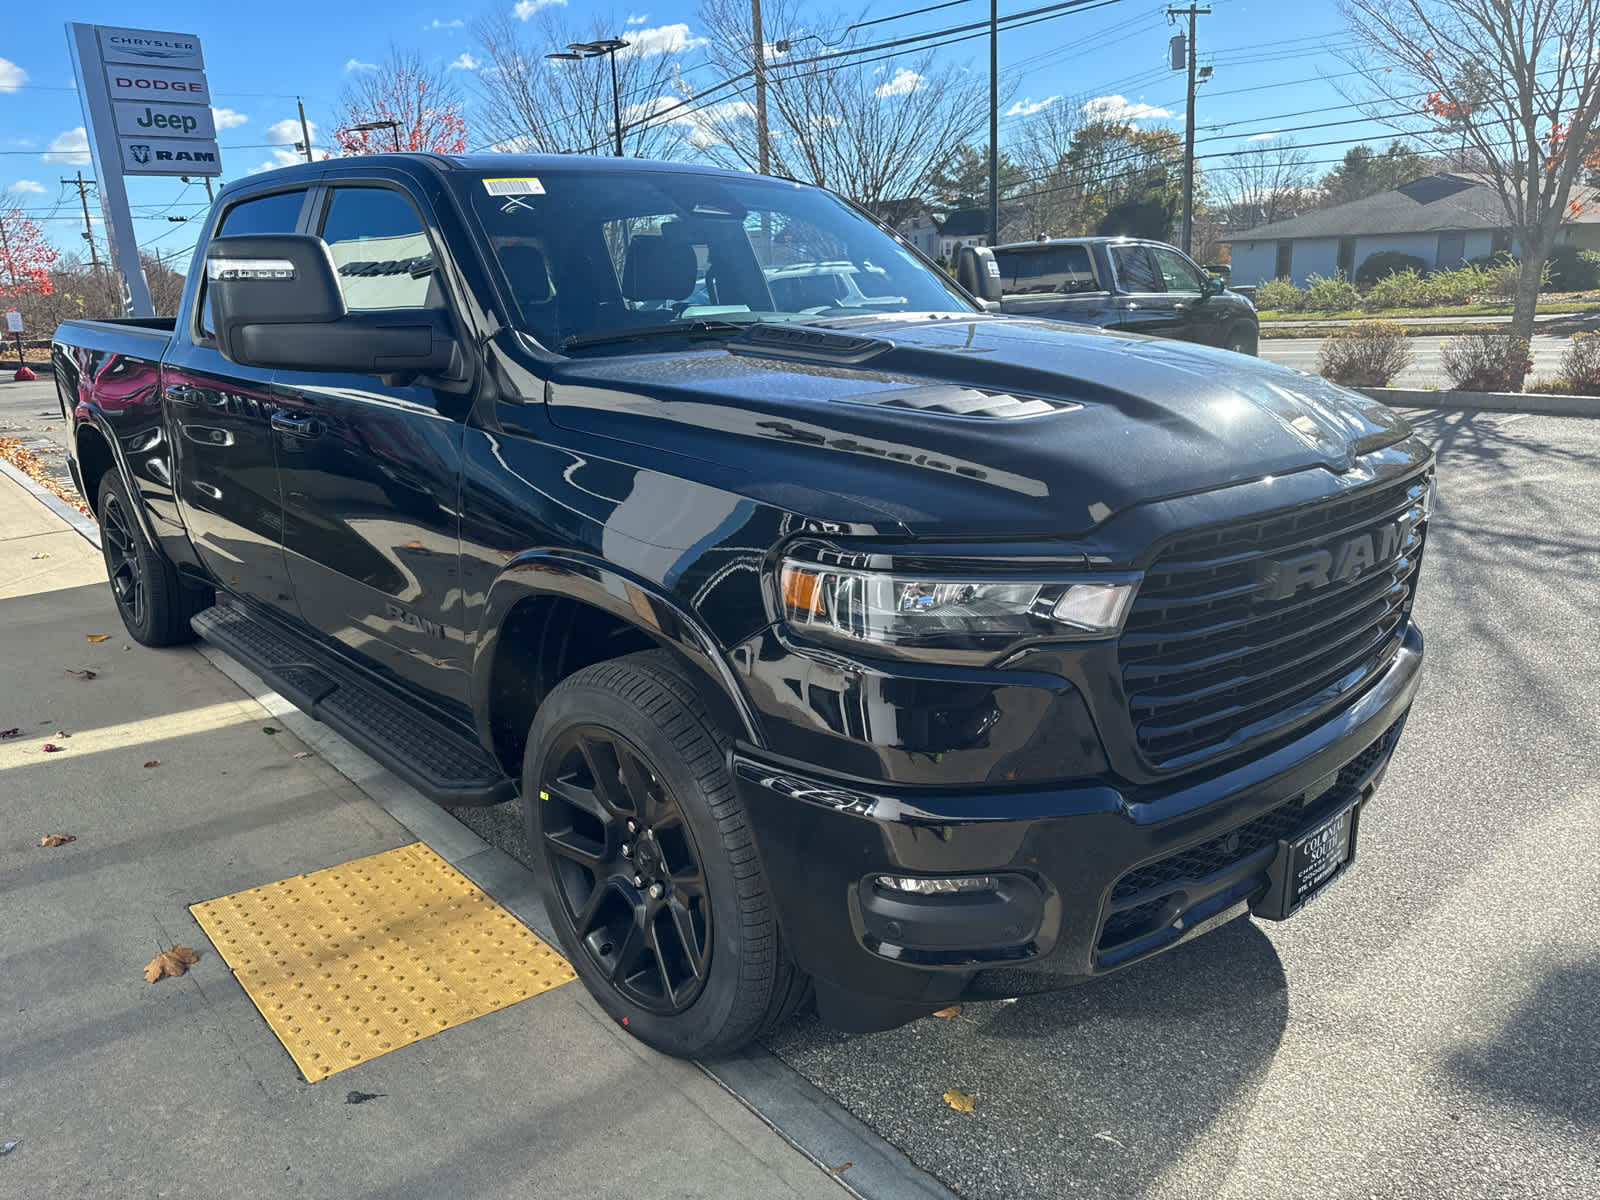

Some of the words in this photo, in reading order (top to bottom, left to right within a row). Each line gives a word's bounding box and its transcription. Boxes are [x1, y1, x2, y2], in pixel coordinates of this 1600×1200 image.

[110, 36, 193, 50] CHRYSLER
[115, 77, 203, 93] DODGE
[136, 107, 197, 134] Jeep
[155, 150, 216, 162] RAM
[1279, 519, 1411, 600] RAM
[385, 601, 442, 640] RAM
[1311, 833, 1338, 862] SOUTH
